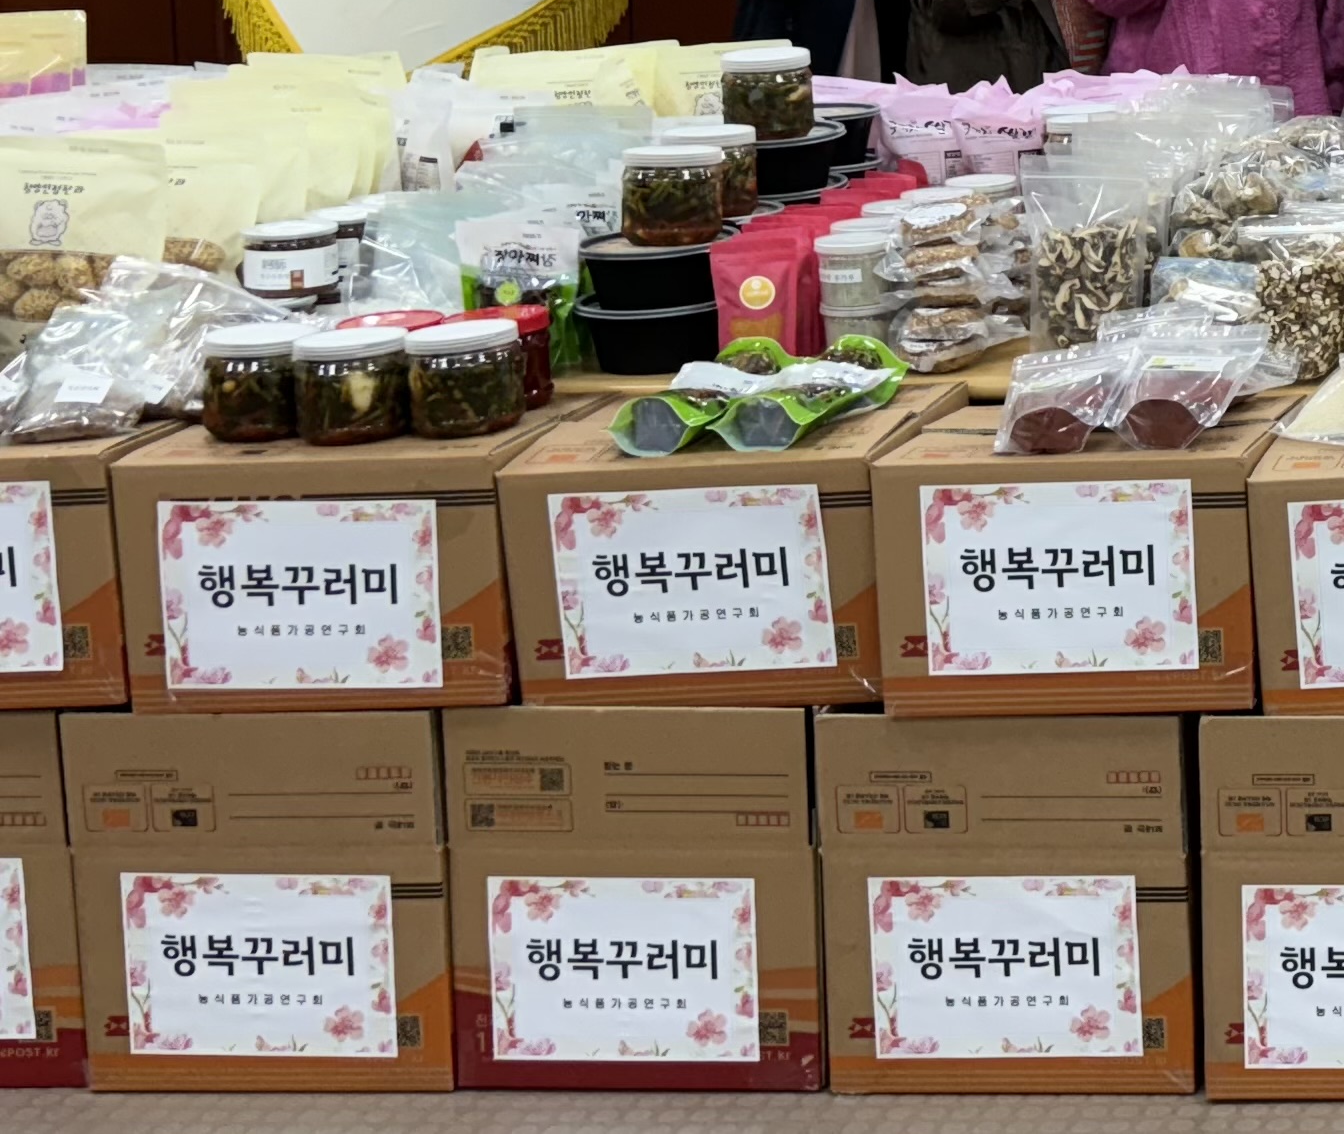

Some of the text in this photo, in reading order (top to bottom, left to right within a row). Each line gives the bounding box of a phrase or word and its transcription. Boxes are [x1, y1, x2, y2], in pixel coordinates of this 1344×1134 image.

[198, 563, 398, 609] 행복꾸러미
[592, 546, 789, 597] 행복꾸러미
[960, 544, 1155, 593] 행복꾸러미
[160, 934, 355, 977] 행복꾸러미
[526, 938, 718, 982] 행복꾸러미
[907, 937, 1100, 980] 행복꾸러미
